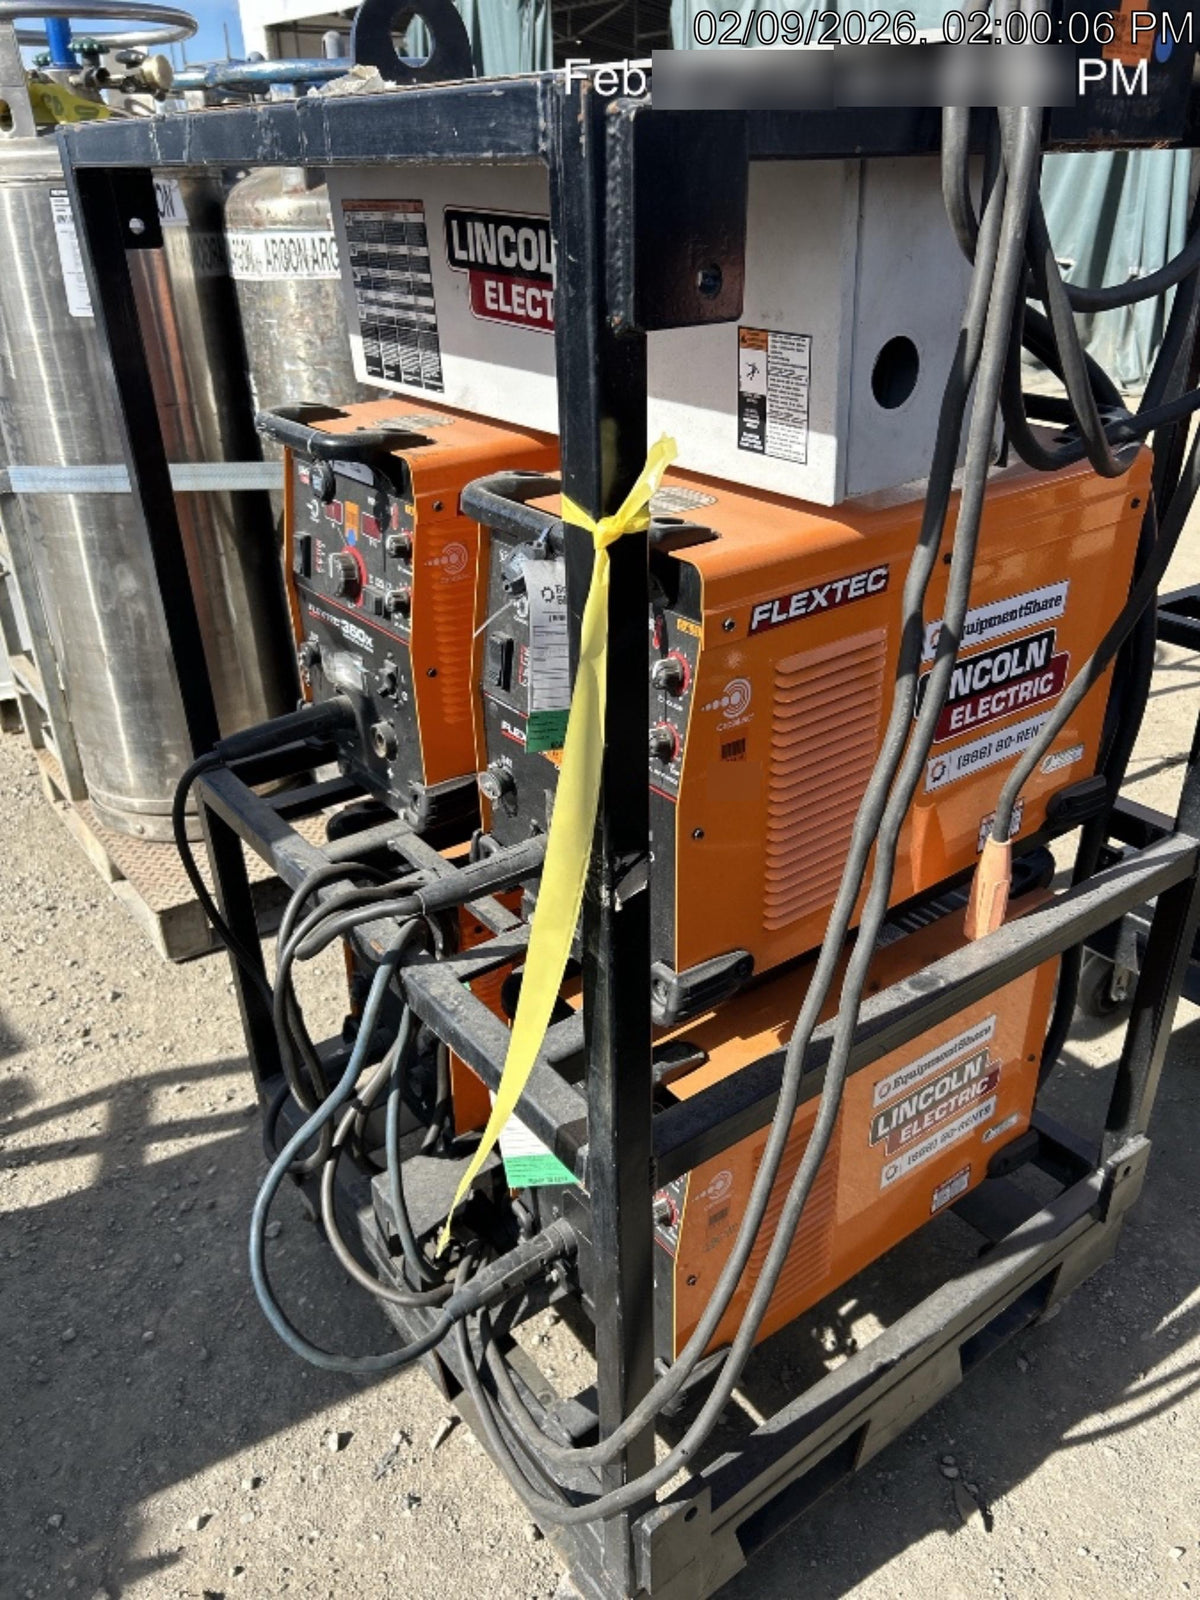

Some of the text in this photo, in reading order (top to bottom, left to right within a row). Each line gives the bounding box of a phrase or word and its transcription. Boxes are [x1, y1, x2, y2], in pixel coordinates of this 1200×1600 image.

[452, 219, 554, 274] LINCOL
[484, 280, 555, 322] ELECT
[751, 567, 888, 630] FLEXTEC
[950, 638, 1048, 699] NCOLN
[950, 672, 1053, 731] ELECTRIC
[877, 1054, 982, 1137] LINCOLN
[901, 1077, 990, 1143] ELECTRIC
